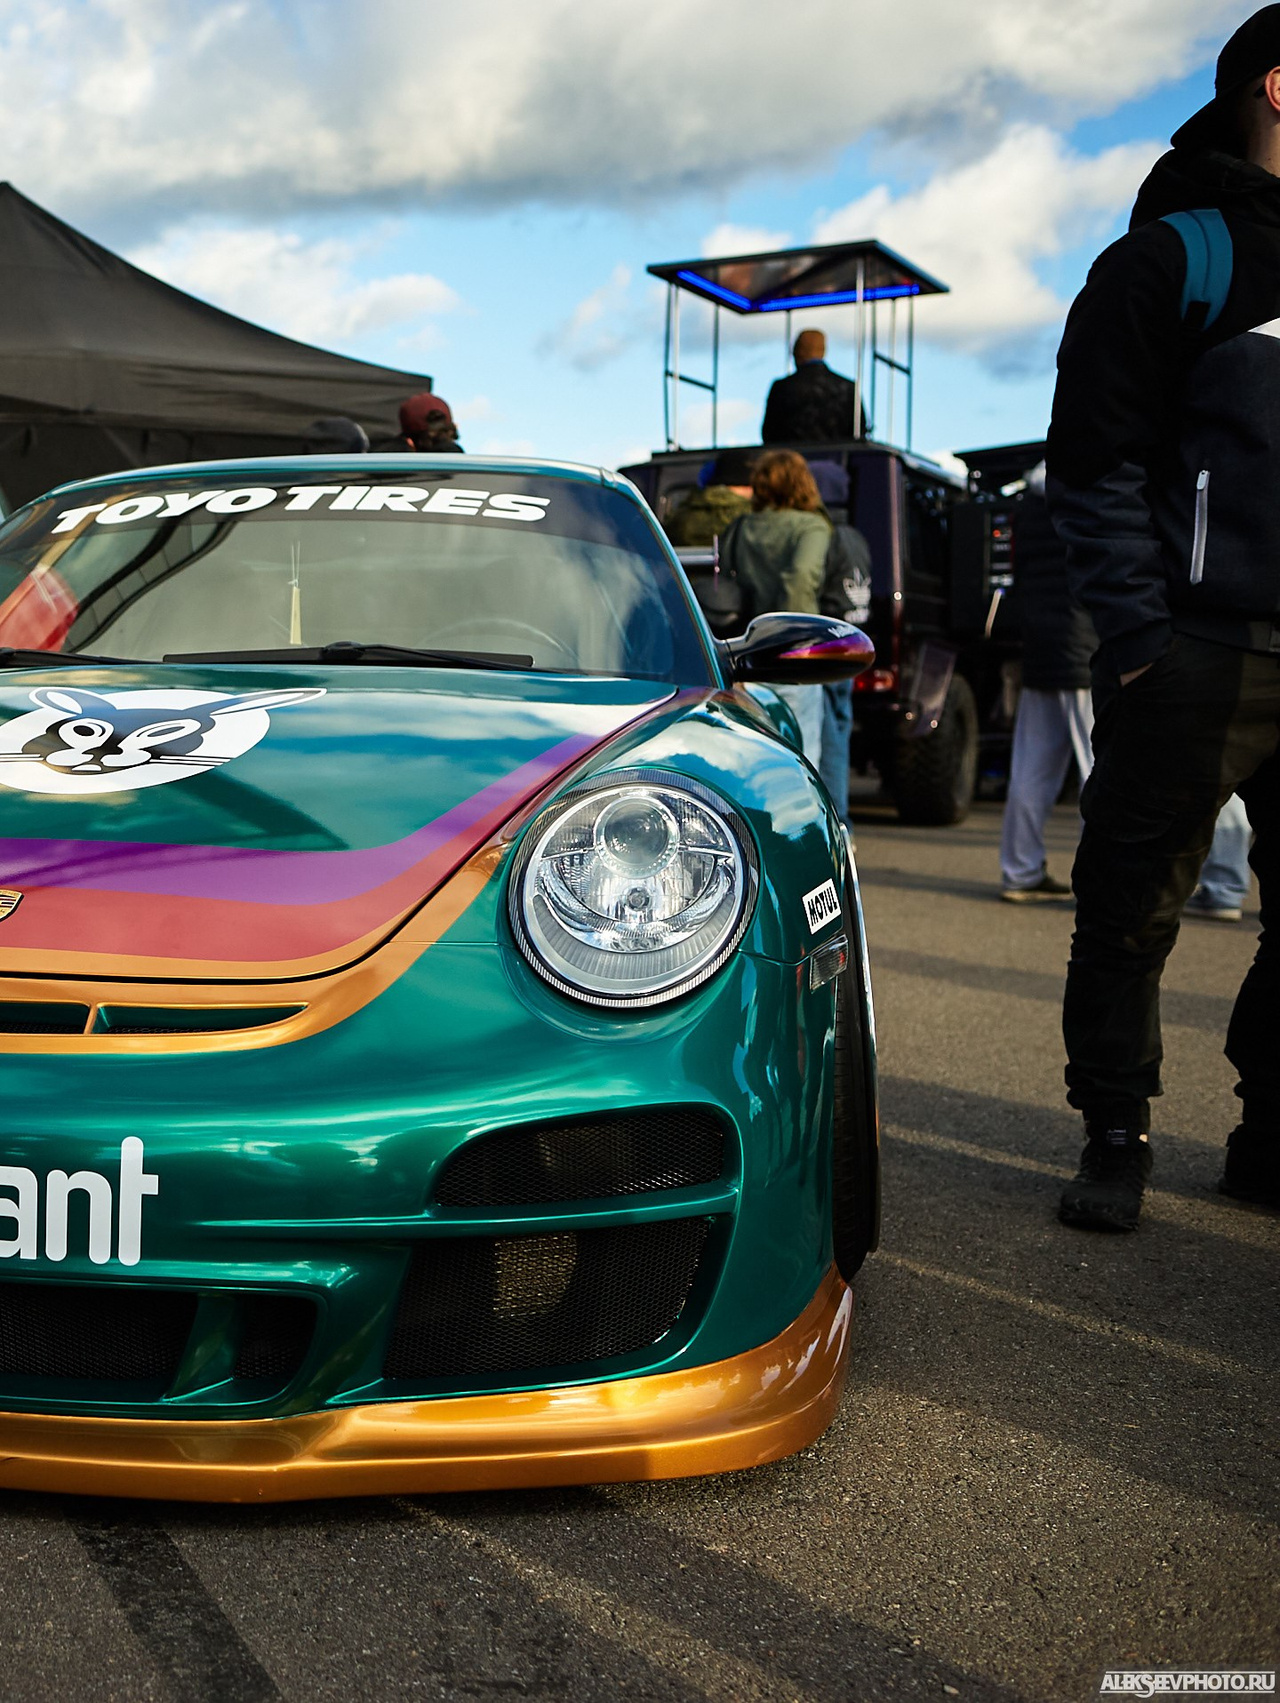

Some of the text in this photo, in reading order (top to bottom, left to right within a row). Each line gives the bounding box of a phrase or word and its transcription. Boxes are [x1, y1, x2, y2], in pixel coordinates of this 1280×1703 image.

[51, 485, 551, 534] TOYO TIRES
[807, 886, 838, 926] MOTUL
